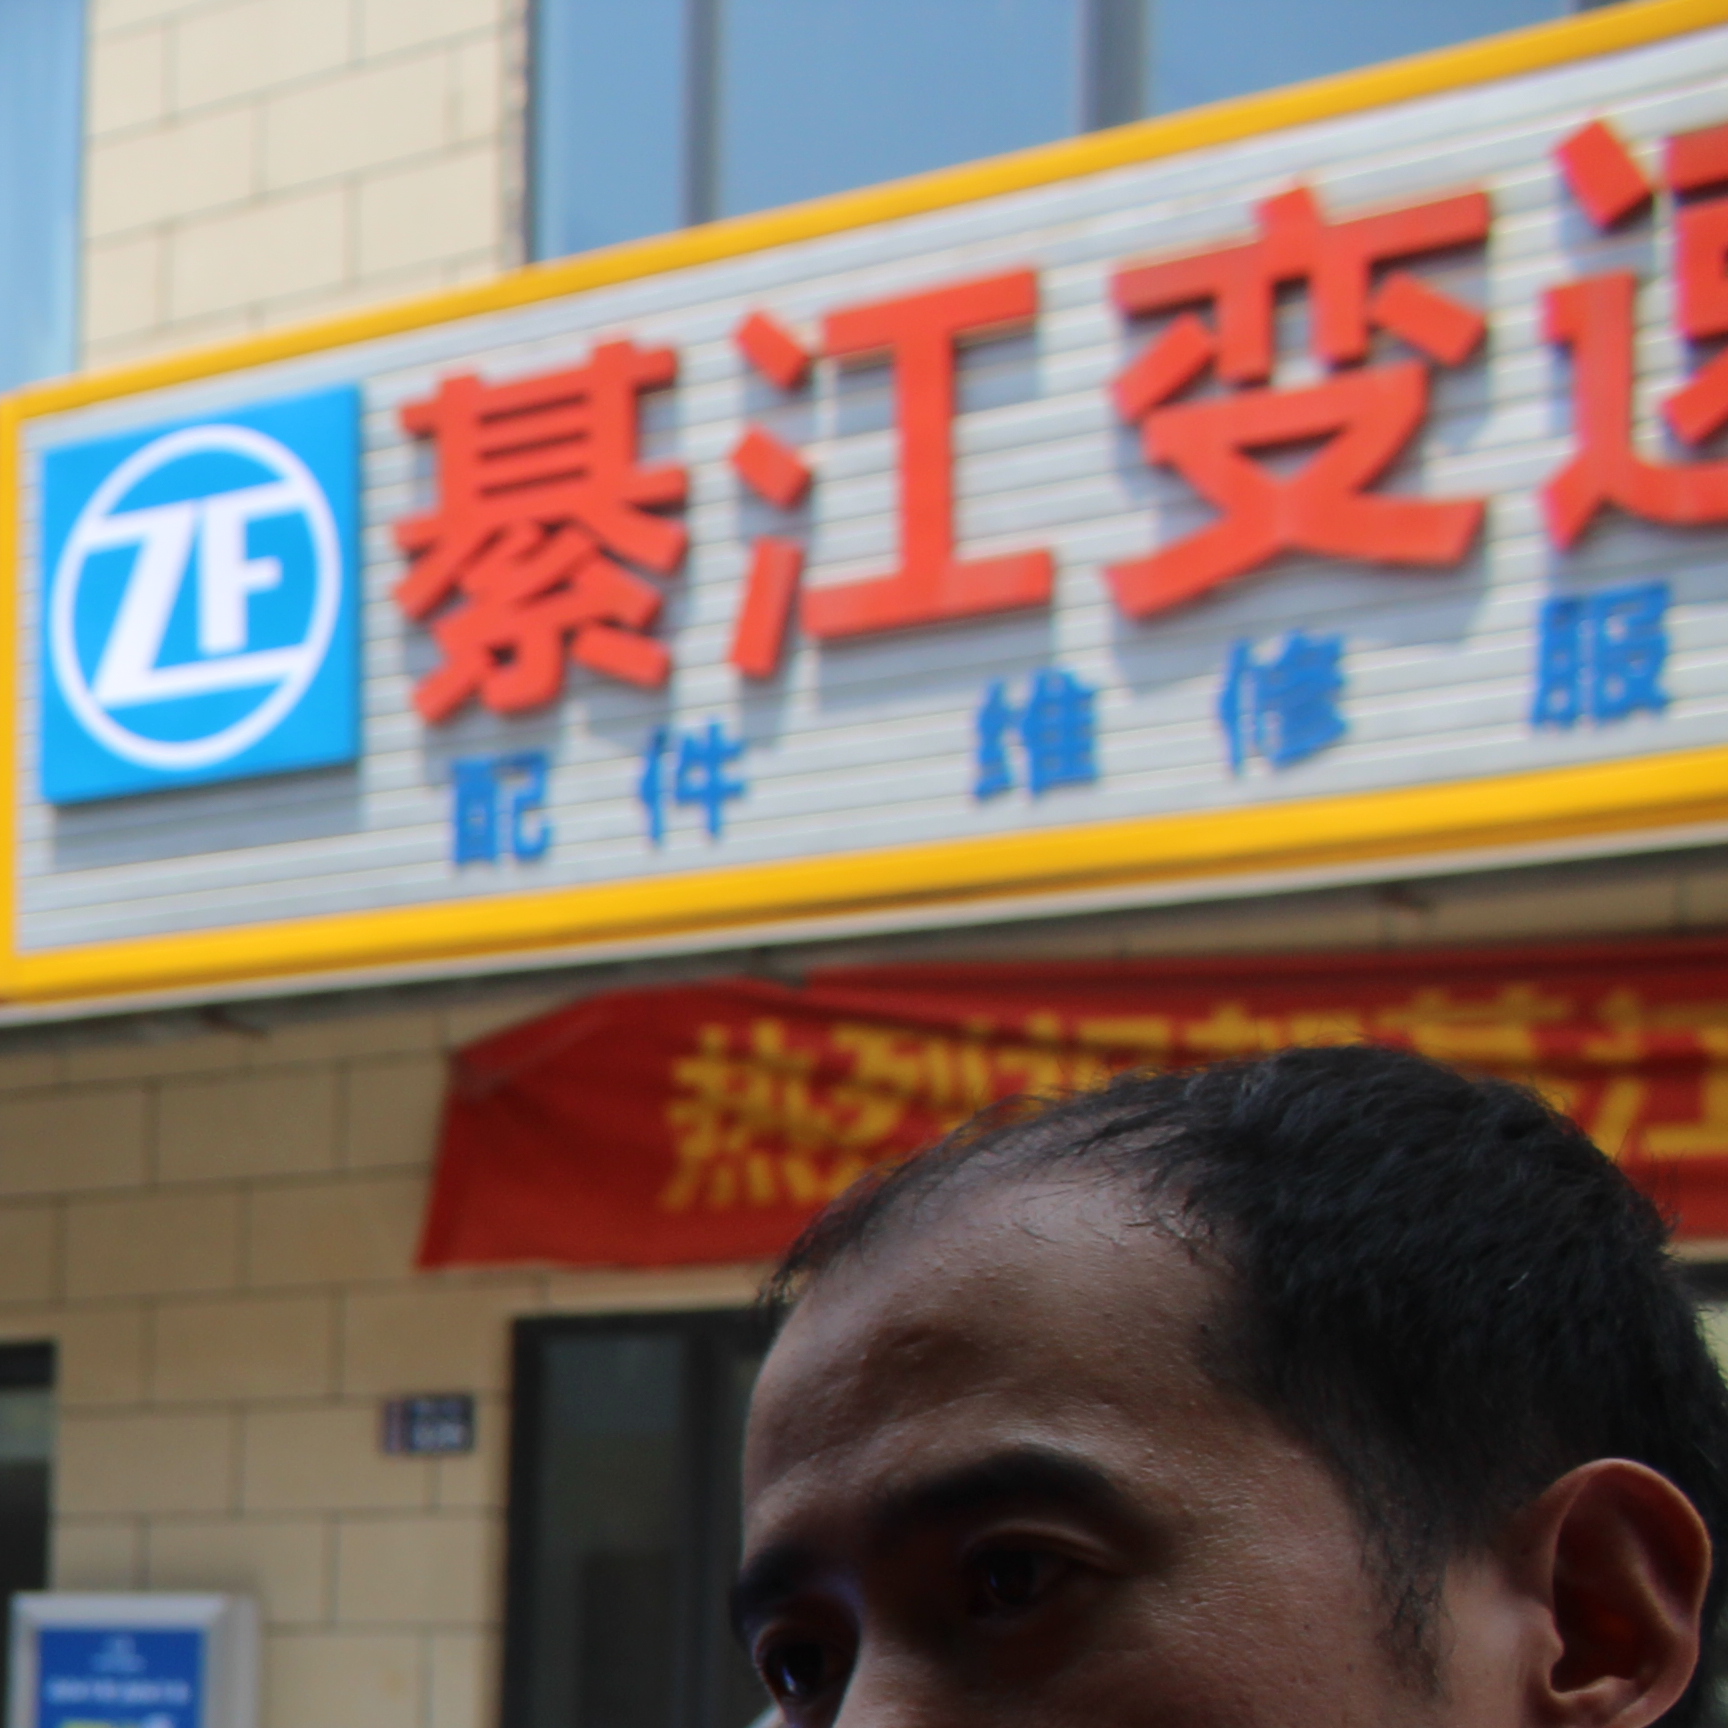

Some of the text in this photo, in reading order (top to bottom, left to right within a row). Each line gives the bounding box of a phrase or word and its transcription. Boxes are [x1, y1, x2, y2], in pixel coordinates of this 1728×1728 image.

[74, 474, 319, 712] ZF
[451, 717, 750, 868] 配件
[972, 628, 1351, 800] 维修
